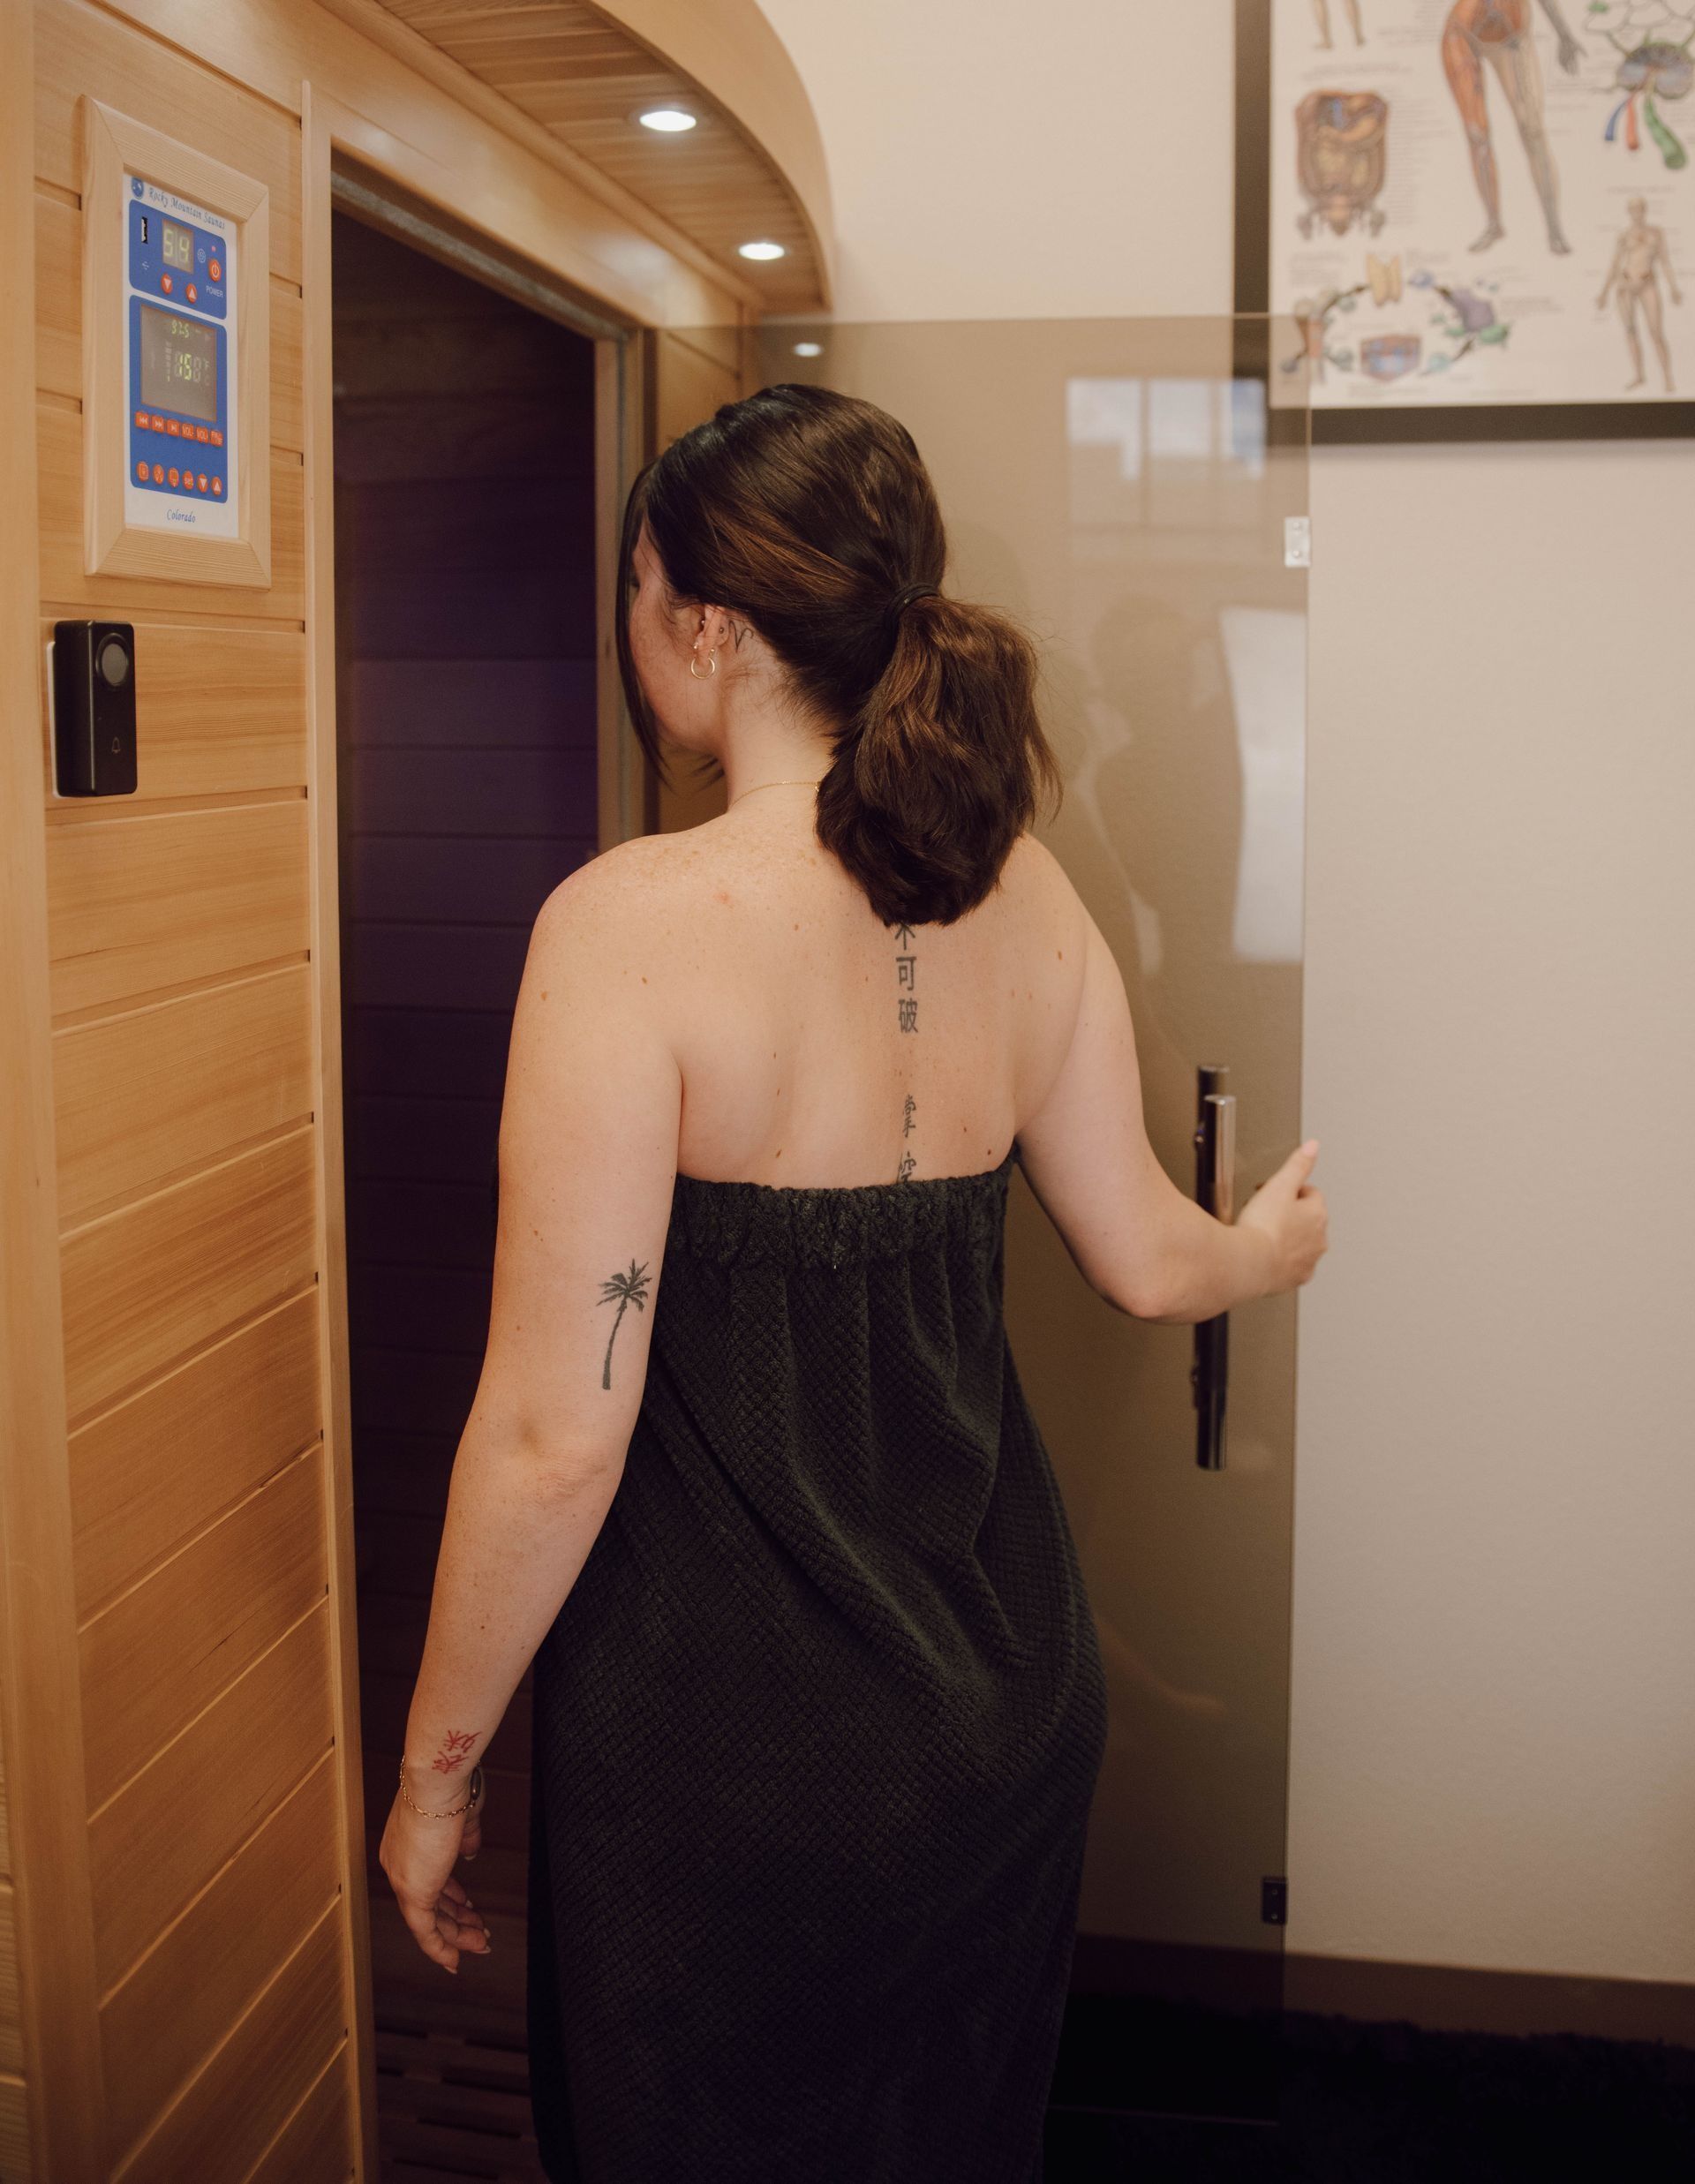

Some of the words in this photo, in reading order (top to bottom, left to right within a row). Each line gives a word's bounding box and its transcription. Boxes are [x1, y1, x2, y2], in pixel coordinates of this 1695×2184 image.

[148, 186, 169, 208] Rocky
[170, 197, 202, 219] Mountain
[206, 284, 224, 298] POWER
[166, 509, 196, 523] Colorado
